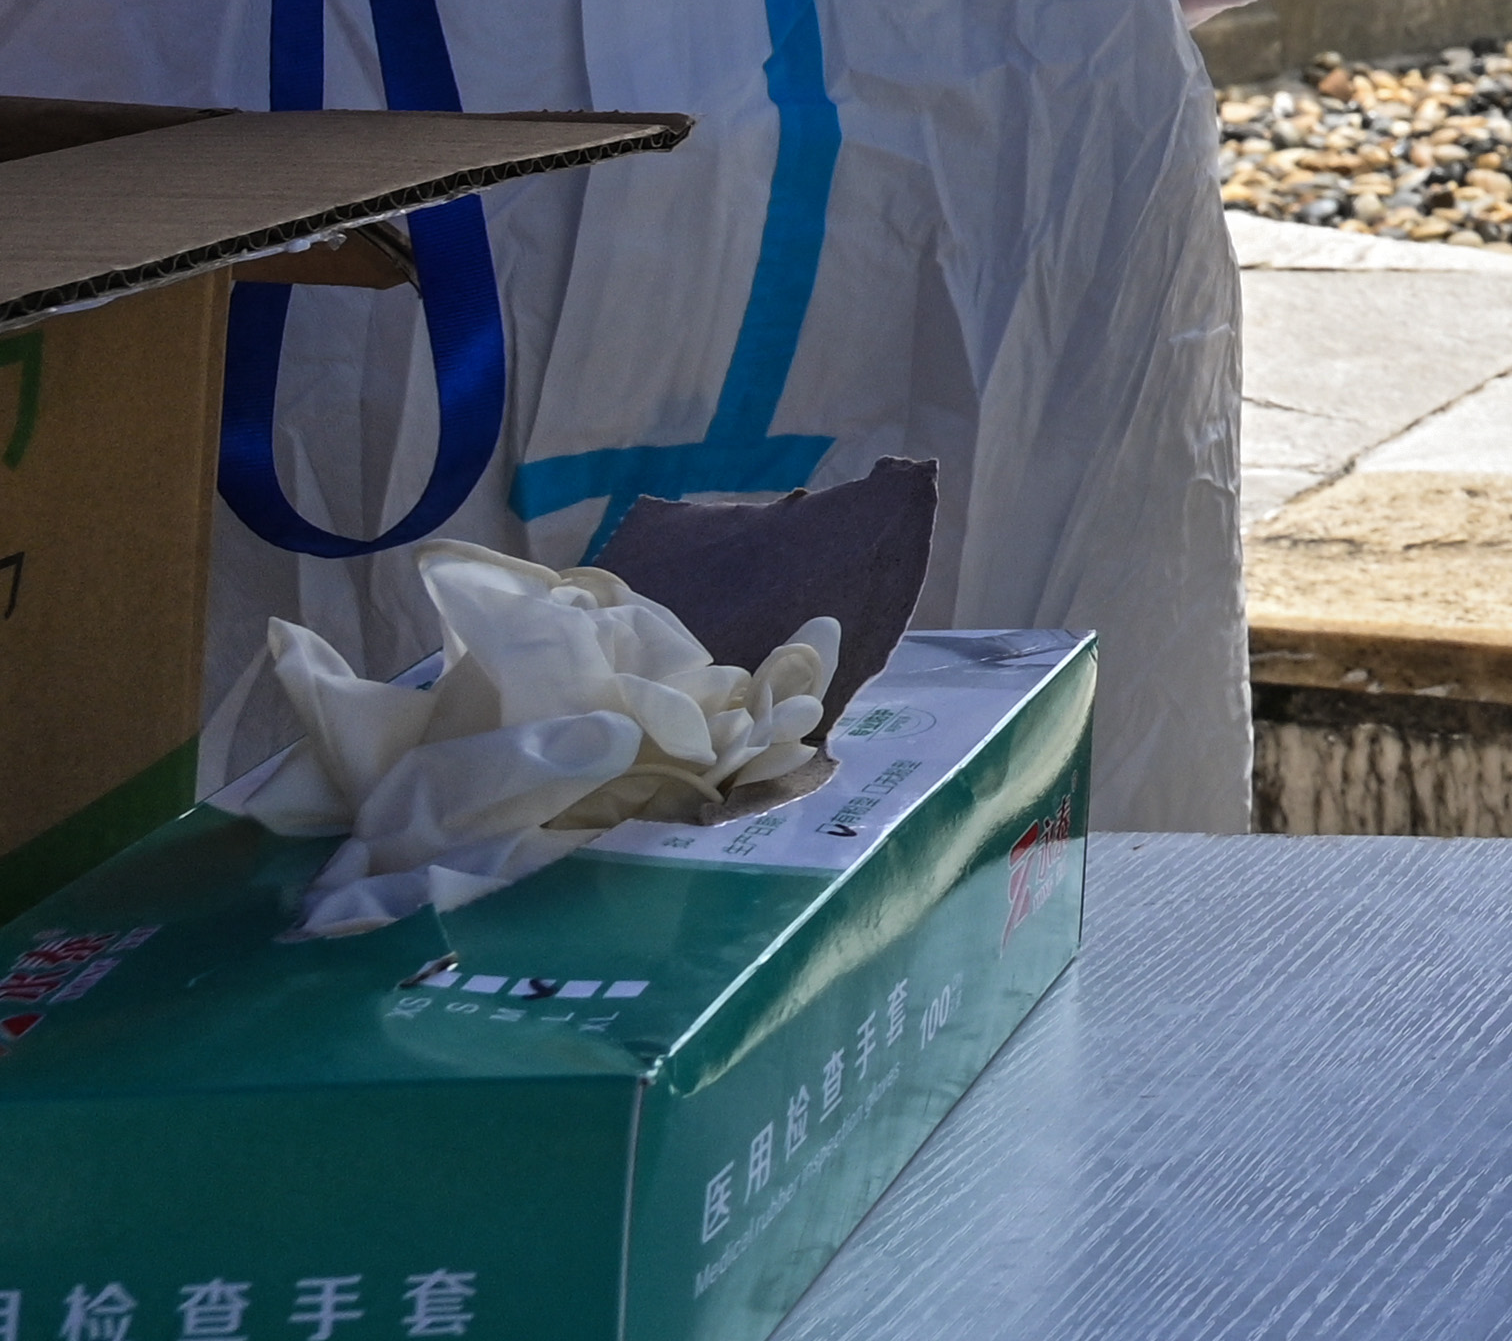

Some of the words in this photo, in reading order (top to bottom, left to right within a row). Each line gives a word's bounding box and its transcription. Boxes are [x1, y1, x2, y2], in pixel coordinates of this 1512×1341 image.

[701, 977, 909, 1245] 医用检查手套
[920, 983, 951, 1051] 100
[0, 1268, 478, 1341] 检查手套
